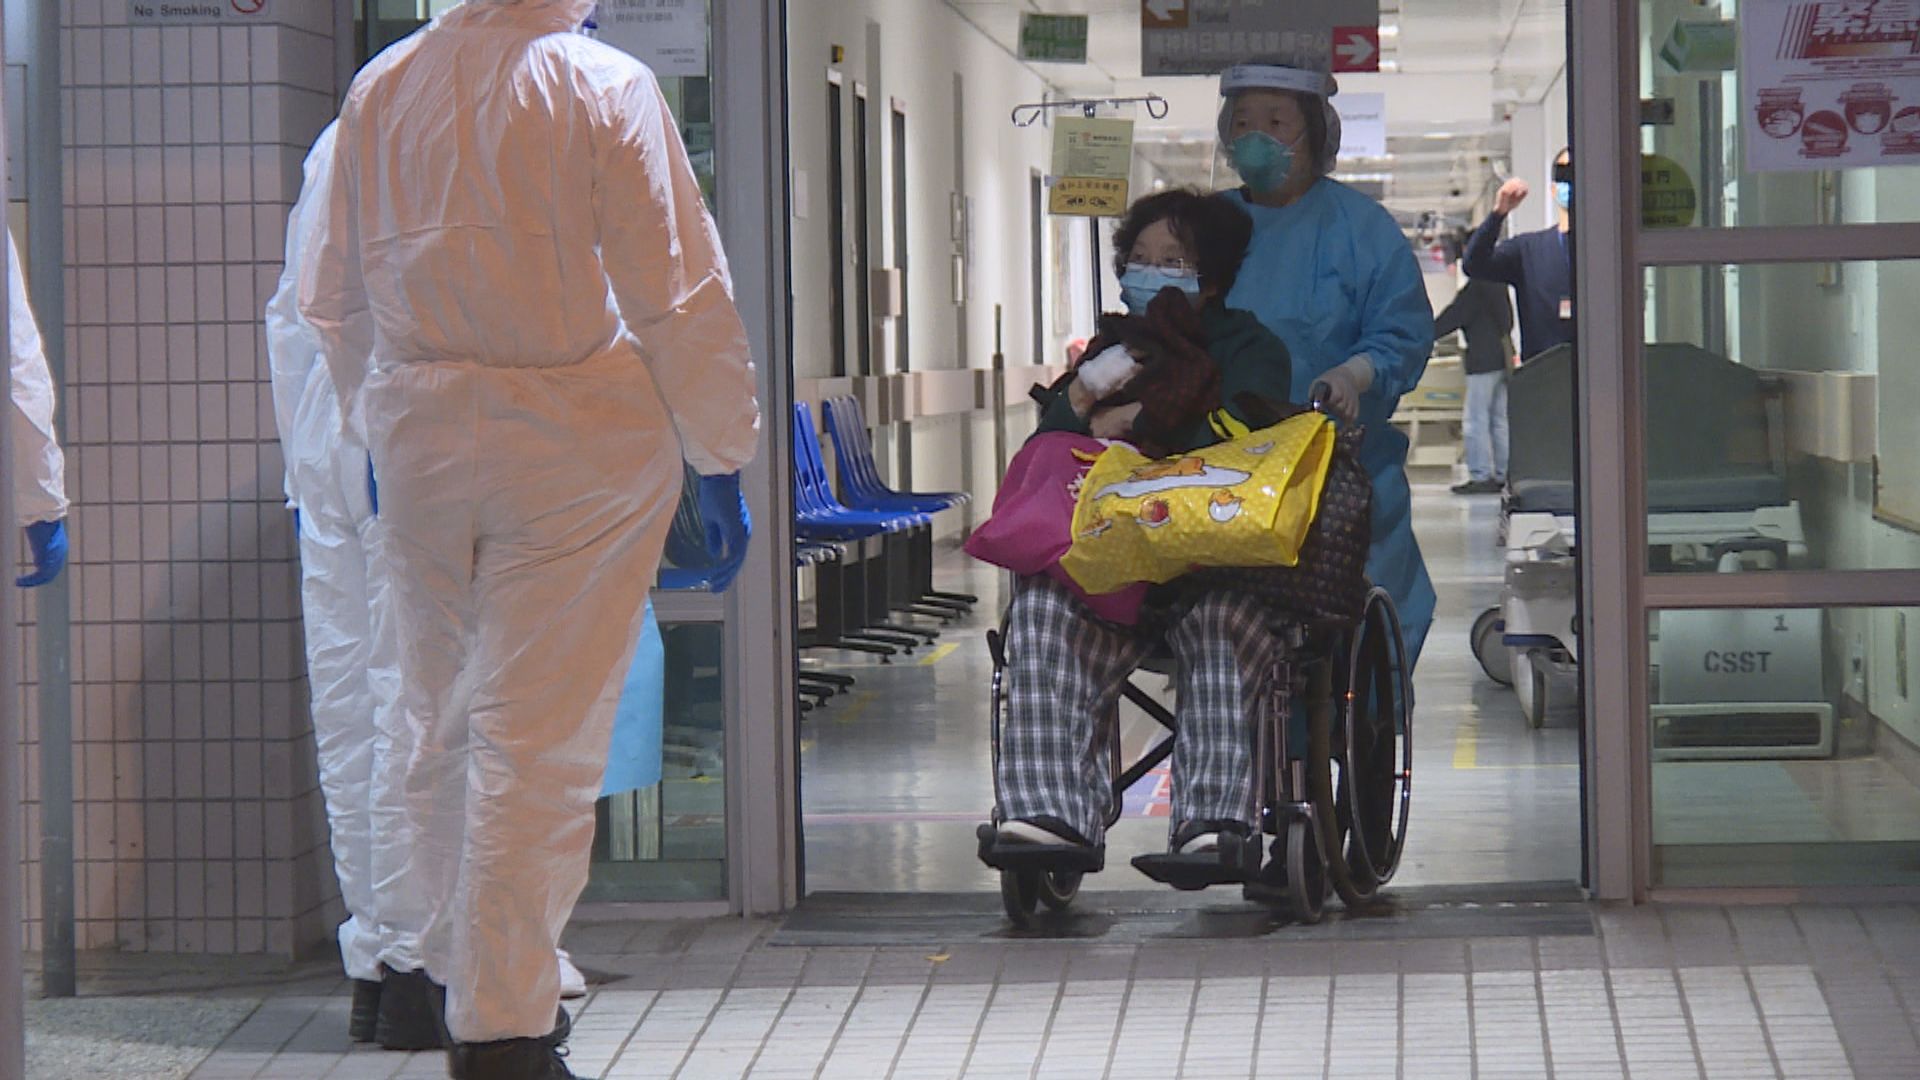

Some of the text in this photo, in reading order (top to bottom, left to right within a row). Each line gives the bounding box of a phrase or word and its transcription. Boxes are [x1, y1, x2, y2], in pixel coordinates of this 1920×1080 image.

[134, 5, 221, 17] No Smoking
[1773, 614, 1789, 632] 1
[1703, 650, 1772, 673] CSST
